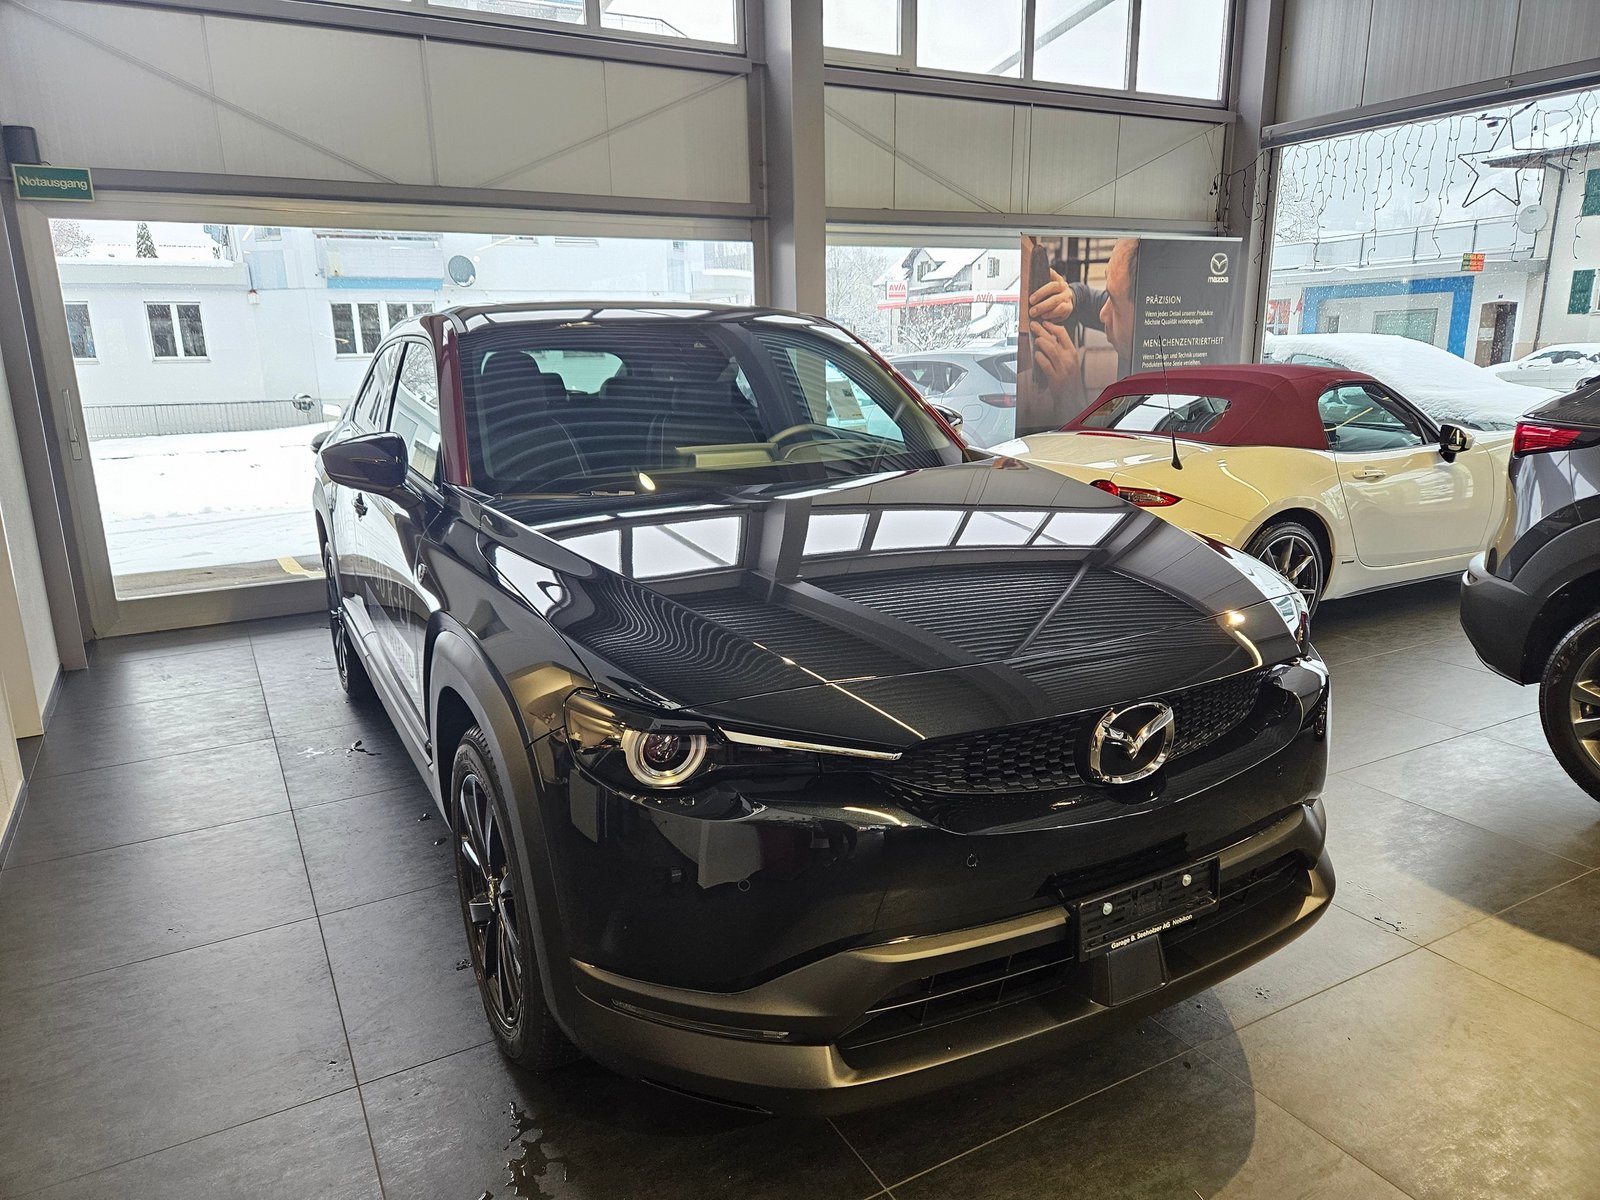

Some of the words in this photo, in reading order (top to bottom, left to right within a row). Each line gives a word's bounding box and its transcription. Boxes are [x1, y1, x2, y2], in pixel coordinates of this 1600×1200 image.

[19, 175, 88, 191] Notausgang
[888, 283, 906, 291] AVIA
[976, 292, 994, 302] AVIA
[1145, 294, 1182, 305] PRÄZISION
[1157, 310, 1169, 318] jedes
[1196, 309, 1214, 317] Produkte
[1160, 318, 1178, 326] Qualität
[1178, 351, 1193, 359] Technik
[1111, 938, 1130, 949] Garage
[1137, 926, 1162, 939] Seeholzer
[1162, 921, 1171, 930] AG
[1172, 914, 1193, 925] Nebikon
